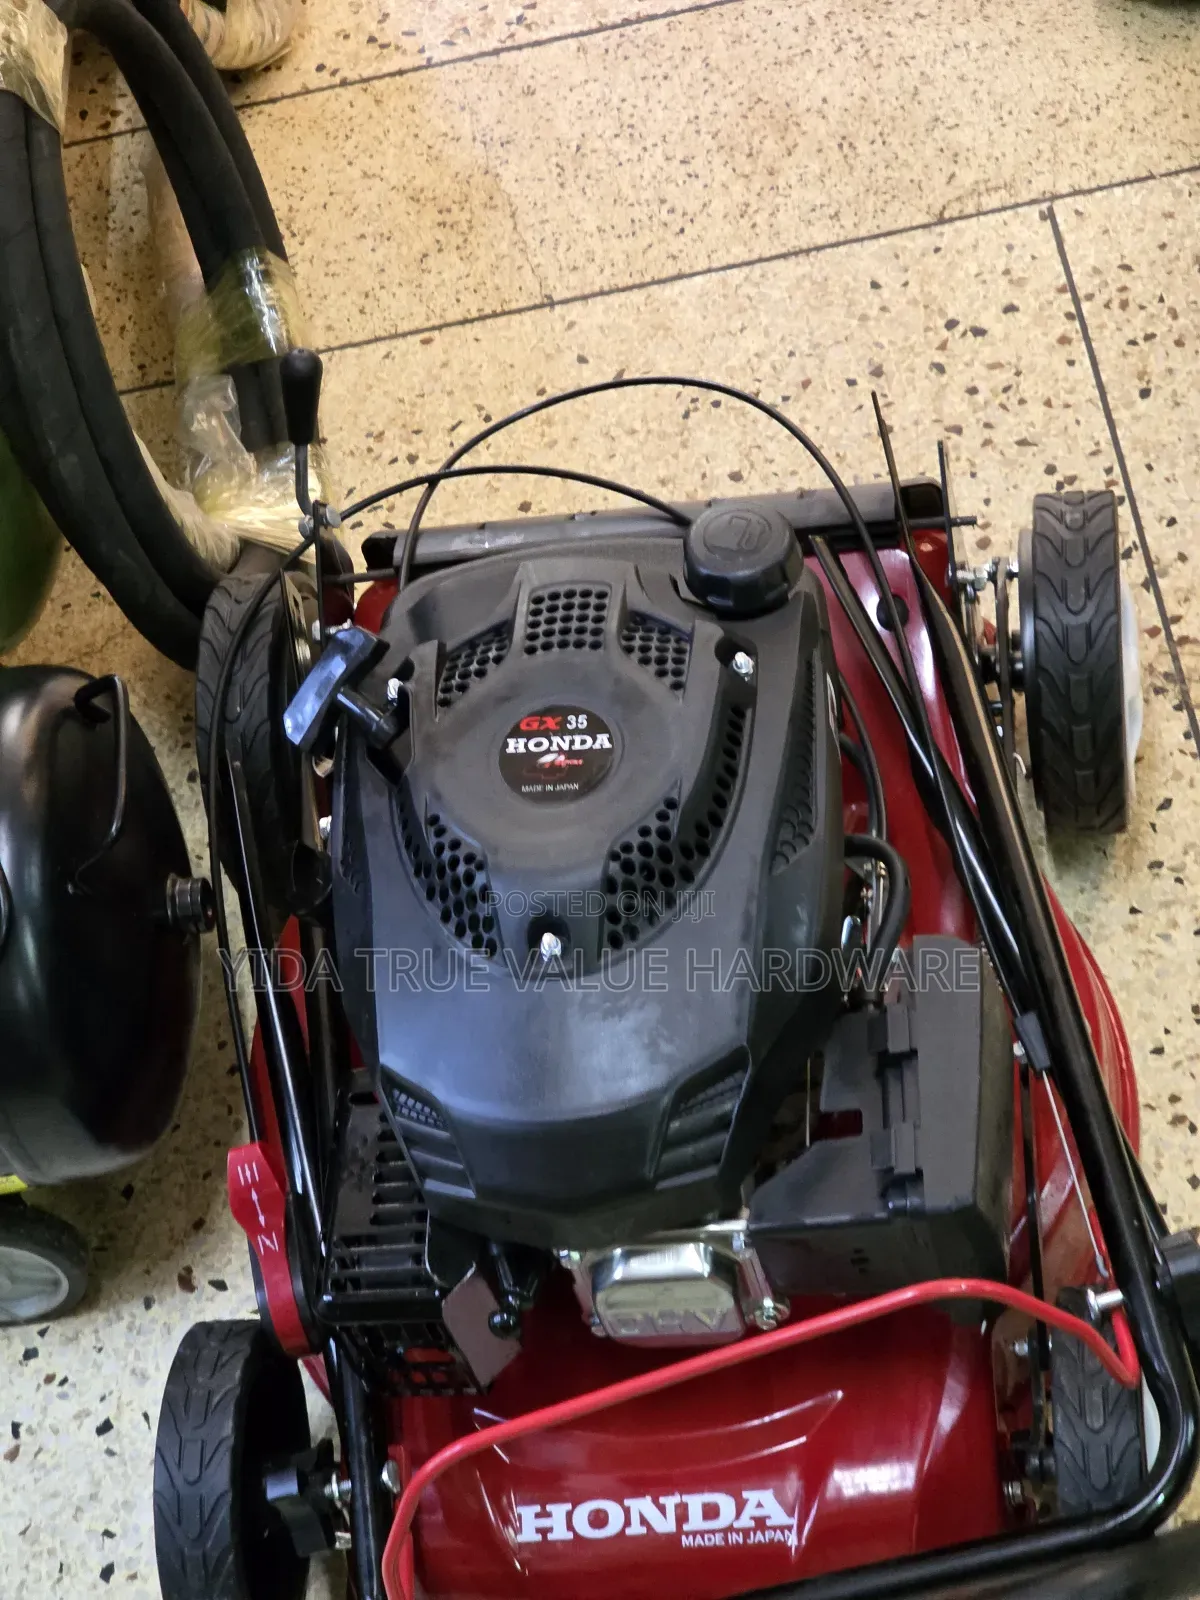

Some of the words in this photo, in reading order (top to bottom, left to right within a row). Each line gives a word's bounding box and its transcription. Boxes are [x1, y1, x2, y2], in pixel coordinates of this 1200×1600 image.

[520, 716, 562, 731] GX
[566, 714, 588, 730] 35
[505, 733, 613, 754] HONDA
[545, 784, 554, 792] IN
[555, 782, 579, 792] JAPAN
[516, 1489, 795, 1542] HONDA
[681, 1532, 725, 1548] MADE
[727, 1531, 743, 1546] IN
[746, 1529, 798, 1547] JAPAN
